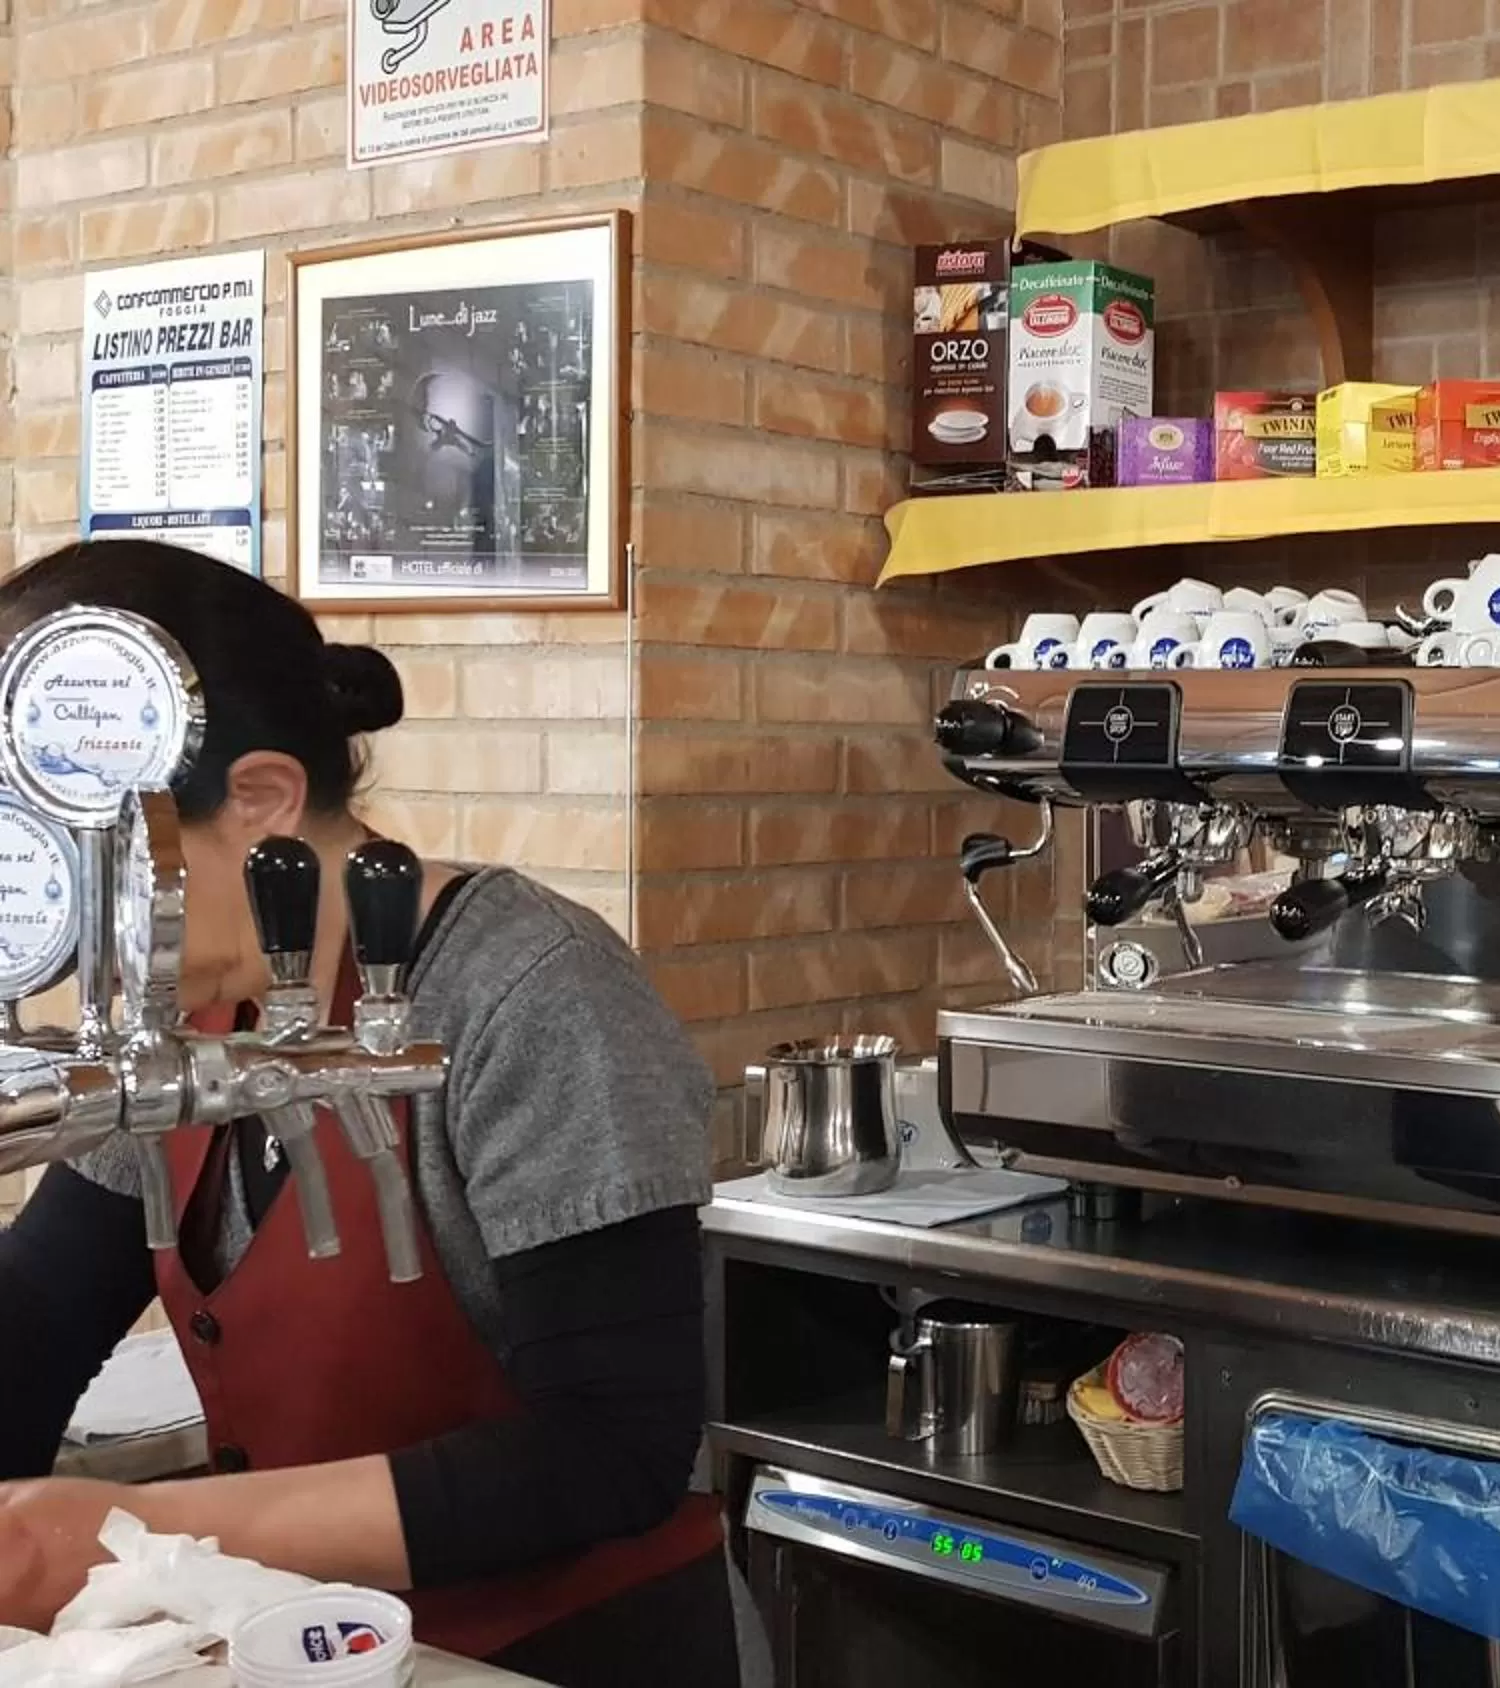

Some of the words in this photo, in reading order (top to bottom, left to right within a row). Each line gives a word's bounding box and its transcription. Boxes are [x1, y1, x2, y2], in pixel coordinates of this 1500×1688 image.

[460, 13, 535, 52] AREA
[360, 52, 538, 108] VIDEOSORVEGLIATA
[160, 304, 206, 317] FOGGIA
[92, 328, 153, 360] LISTINO
[157, 322, 215, 354] PREZZI
[220, 317, 253, 348] BAR
[931, 339, 989, 362] ORZO
[400, 560, 435, 575] HOTEL
[44, 674, 107, 691] Azzurra
[111, 675, 132, 689] srl
[74, 735, 142, 752] frizzante
